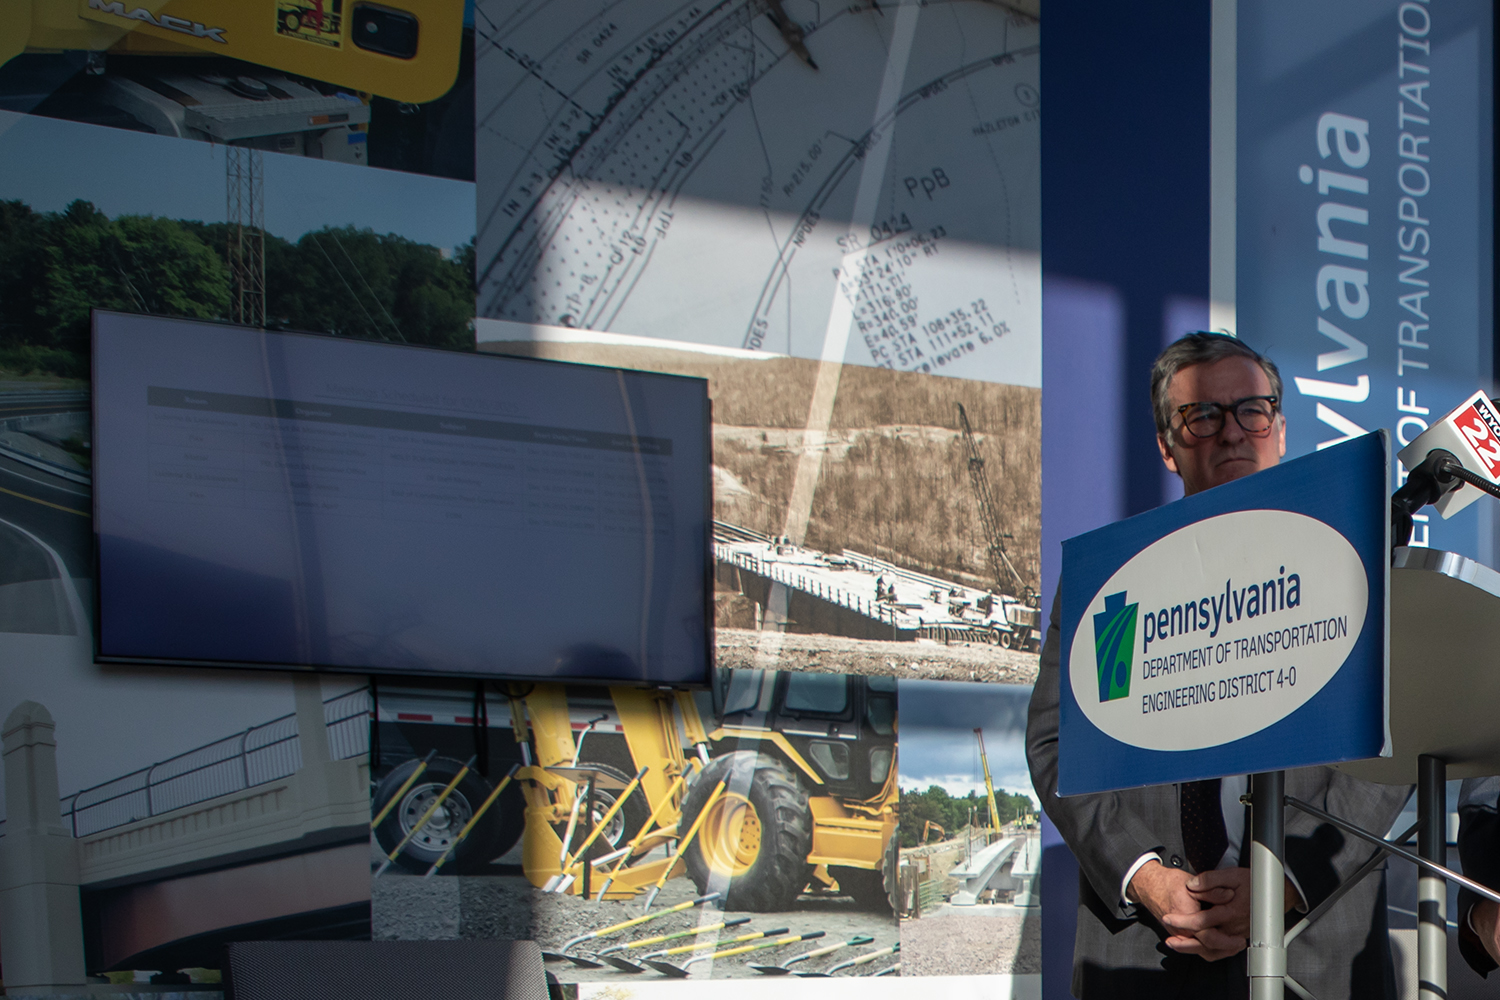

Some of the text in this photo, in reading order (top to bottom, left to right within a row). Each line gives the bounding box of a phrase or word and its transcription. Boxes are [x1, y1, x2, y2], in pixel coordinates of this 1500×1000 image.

[89, 0, 228, 44] MACK
[903, 167, 951, 202] PpB
[1398, 0, 1431, 376] TRANSPORTATIO
[792, 209, 822, 248] NPDES
[835, 212, 913, 254] SR 0424
[871, 346, 889, 363] PC
[891, 333, 918, 353] STA
[898, 346, 924, 368] STA
[1143, 565, 1301, 655] pennsylvania
[1142, 615, 1348, 680] DEPARTMENT OF TRANSPORTATION
[1142, 666, 1297, 714] ENGINEERING DISTRICT 4-0
